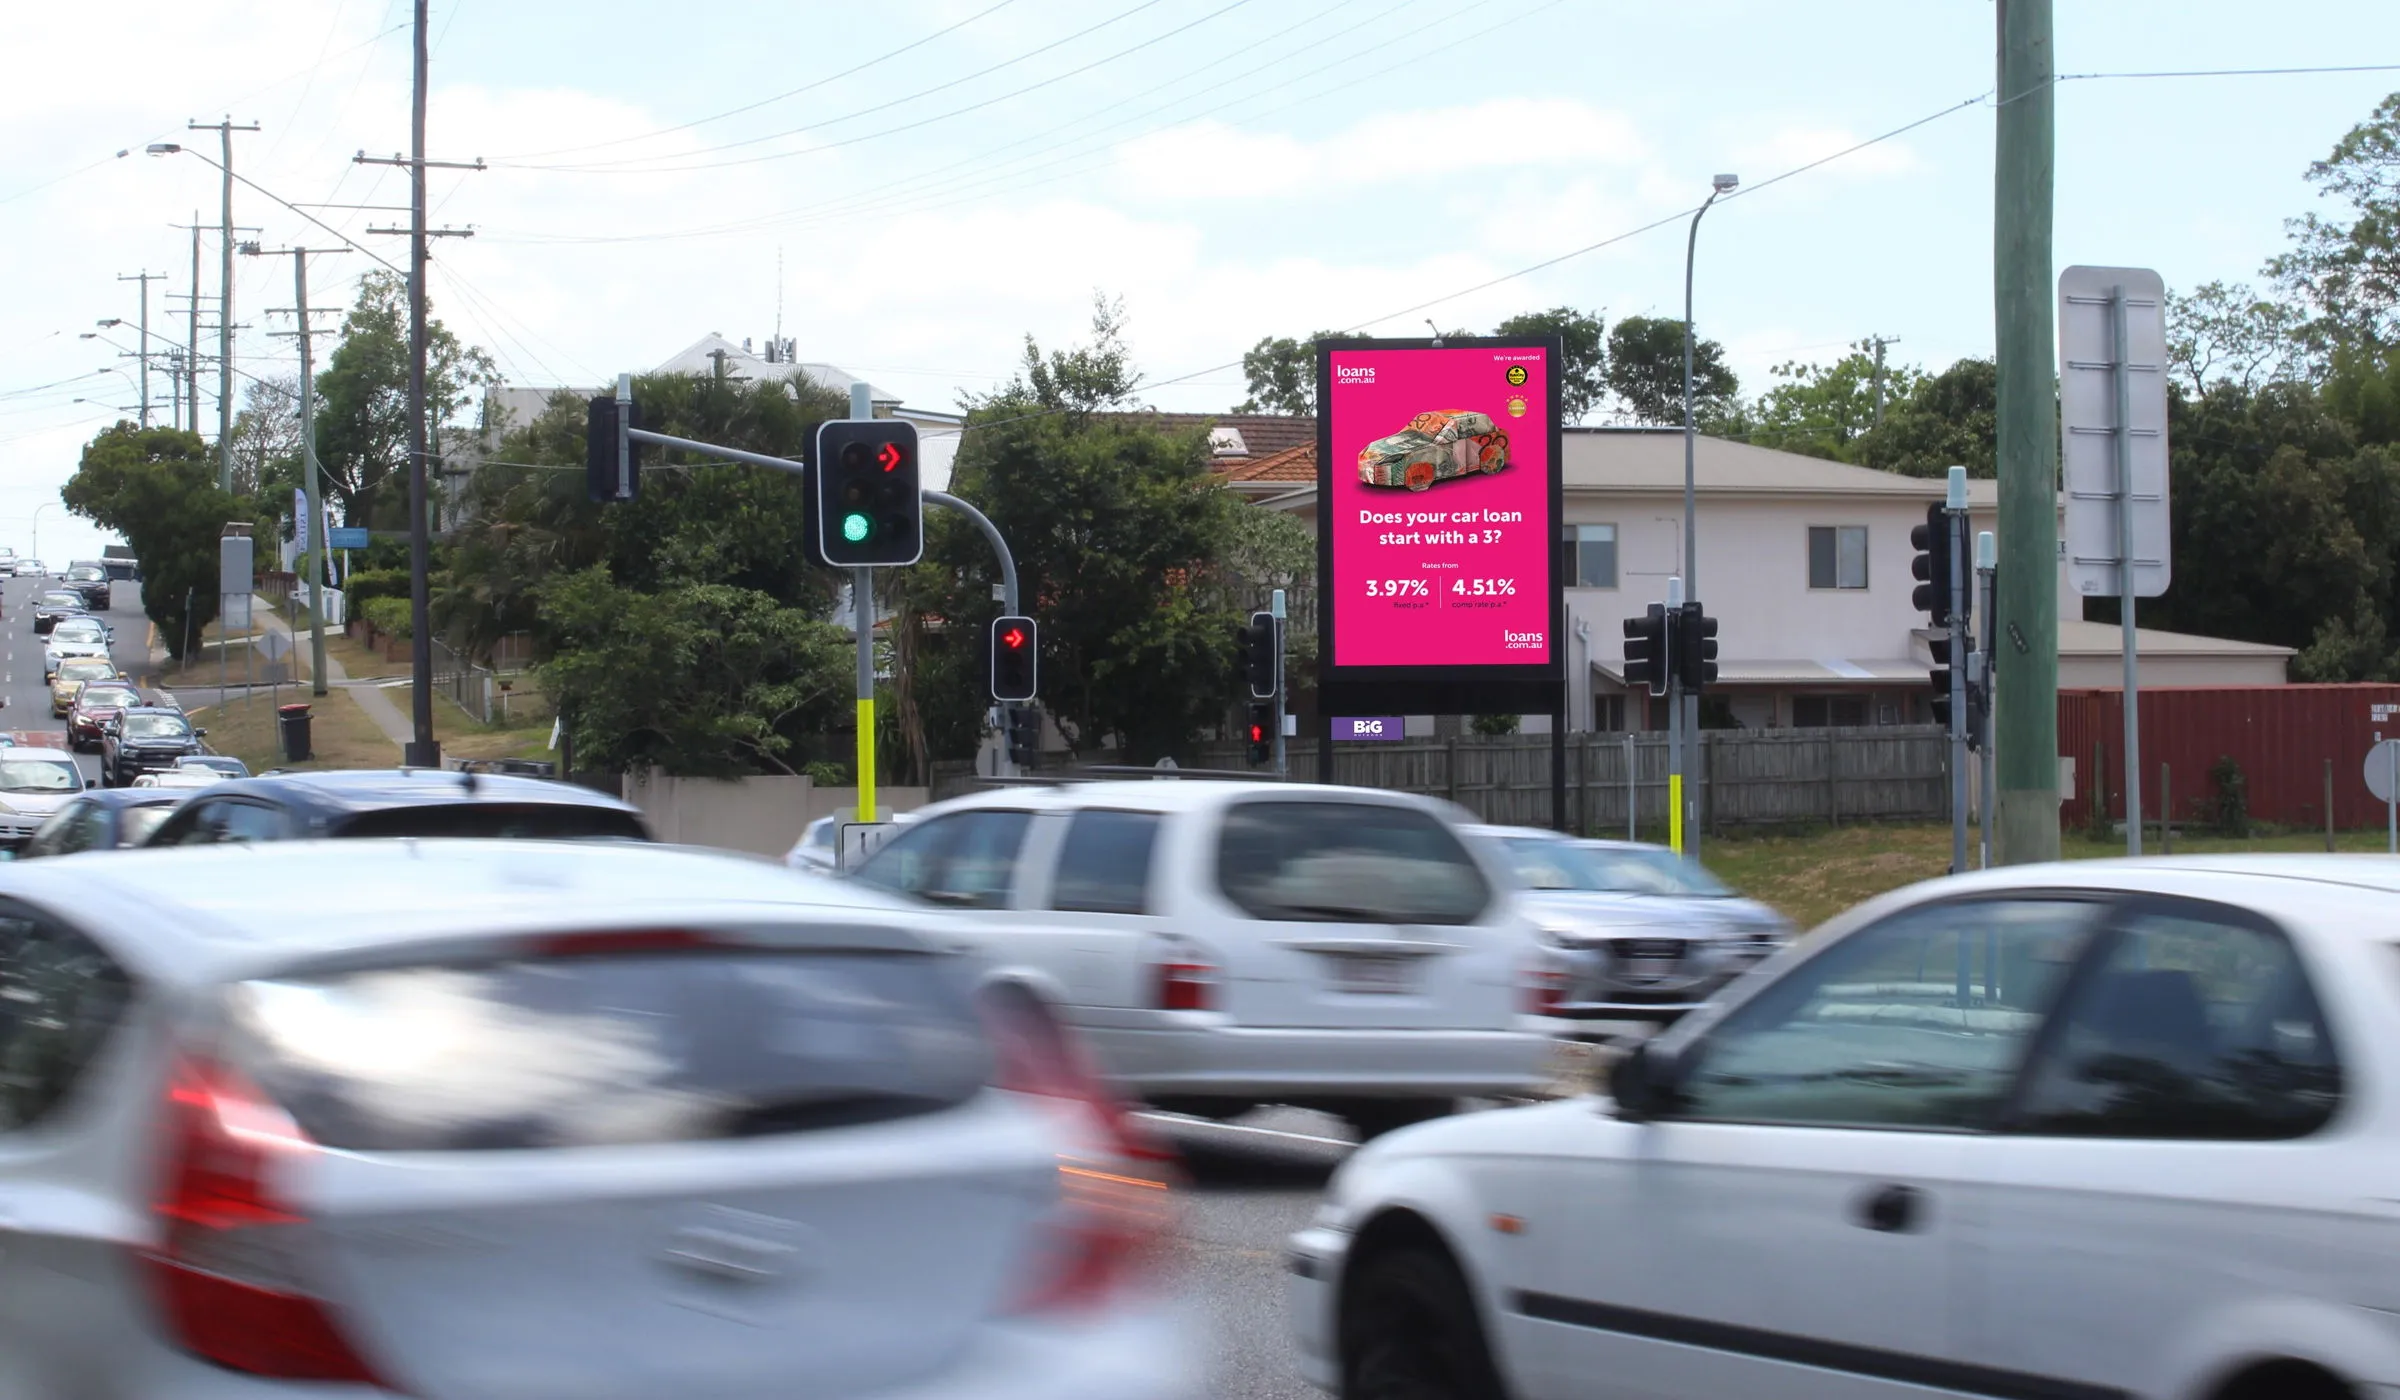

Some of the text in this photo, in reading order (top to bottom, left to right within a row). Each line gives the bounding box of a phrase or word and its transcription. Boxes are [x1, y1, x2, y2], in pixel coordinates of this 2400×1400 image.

[1337, 365, 1375, 377] loans
[1337, 376, 1375, 384] .com.au
[1359, 509, 1522, 527] Does your car loan
[1379, 529, 1503, 545] start with a 3?
[1365, 579, 1429, 597] 3.97%
[1452, 578, 1516, 596] 4.51%
[1504, 629, 1543, 642] loans
[1505, 641, 1543, 649] .com.au
